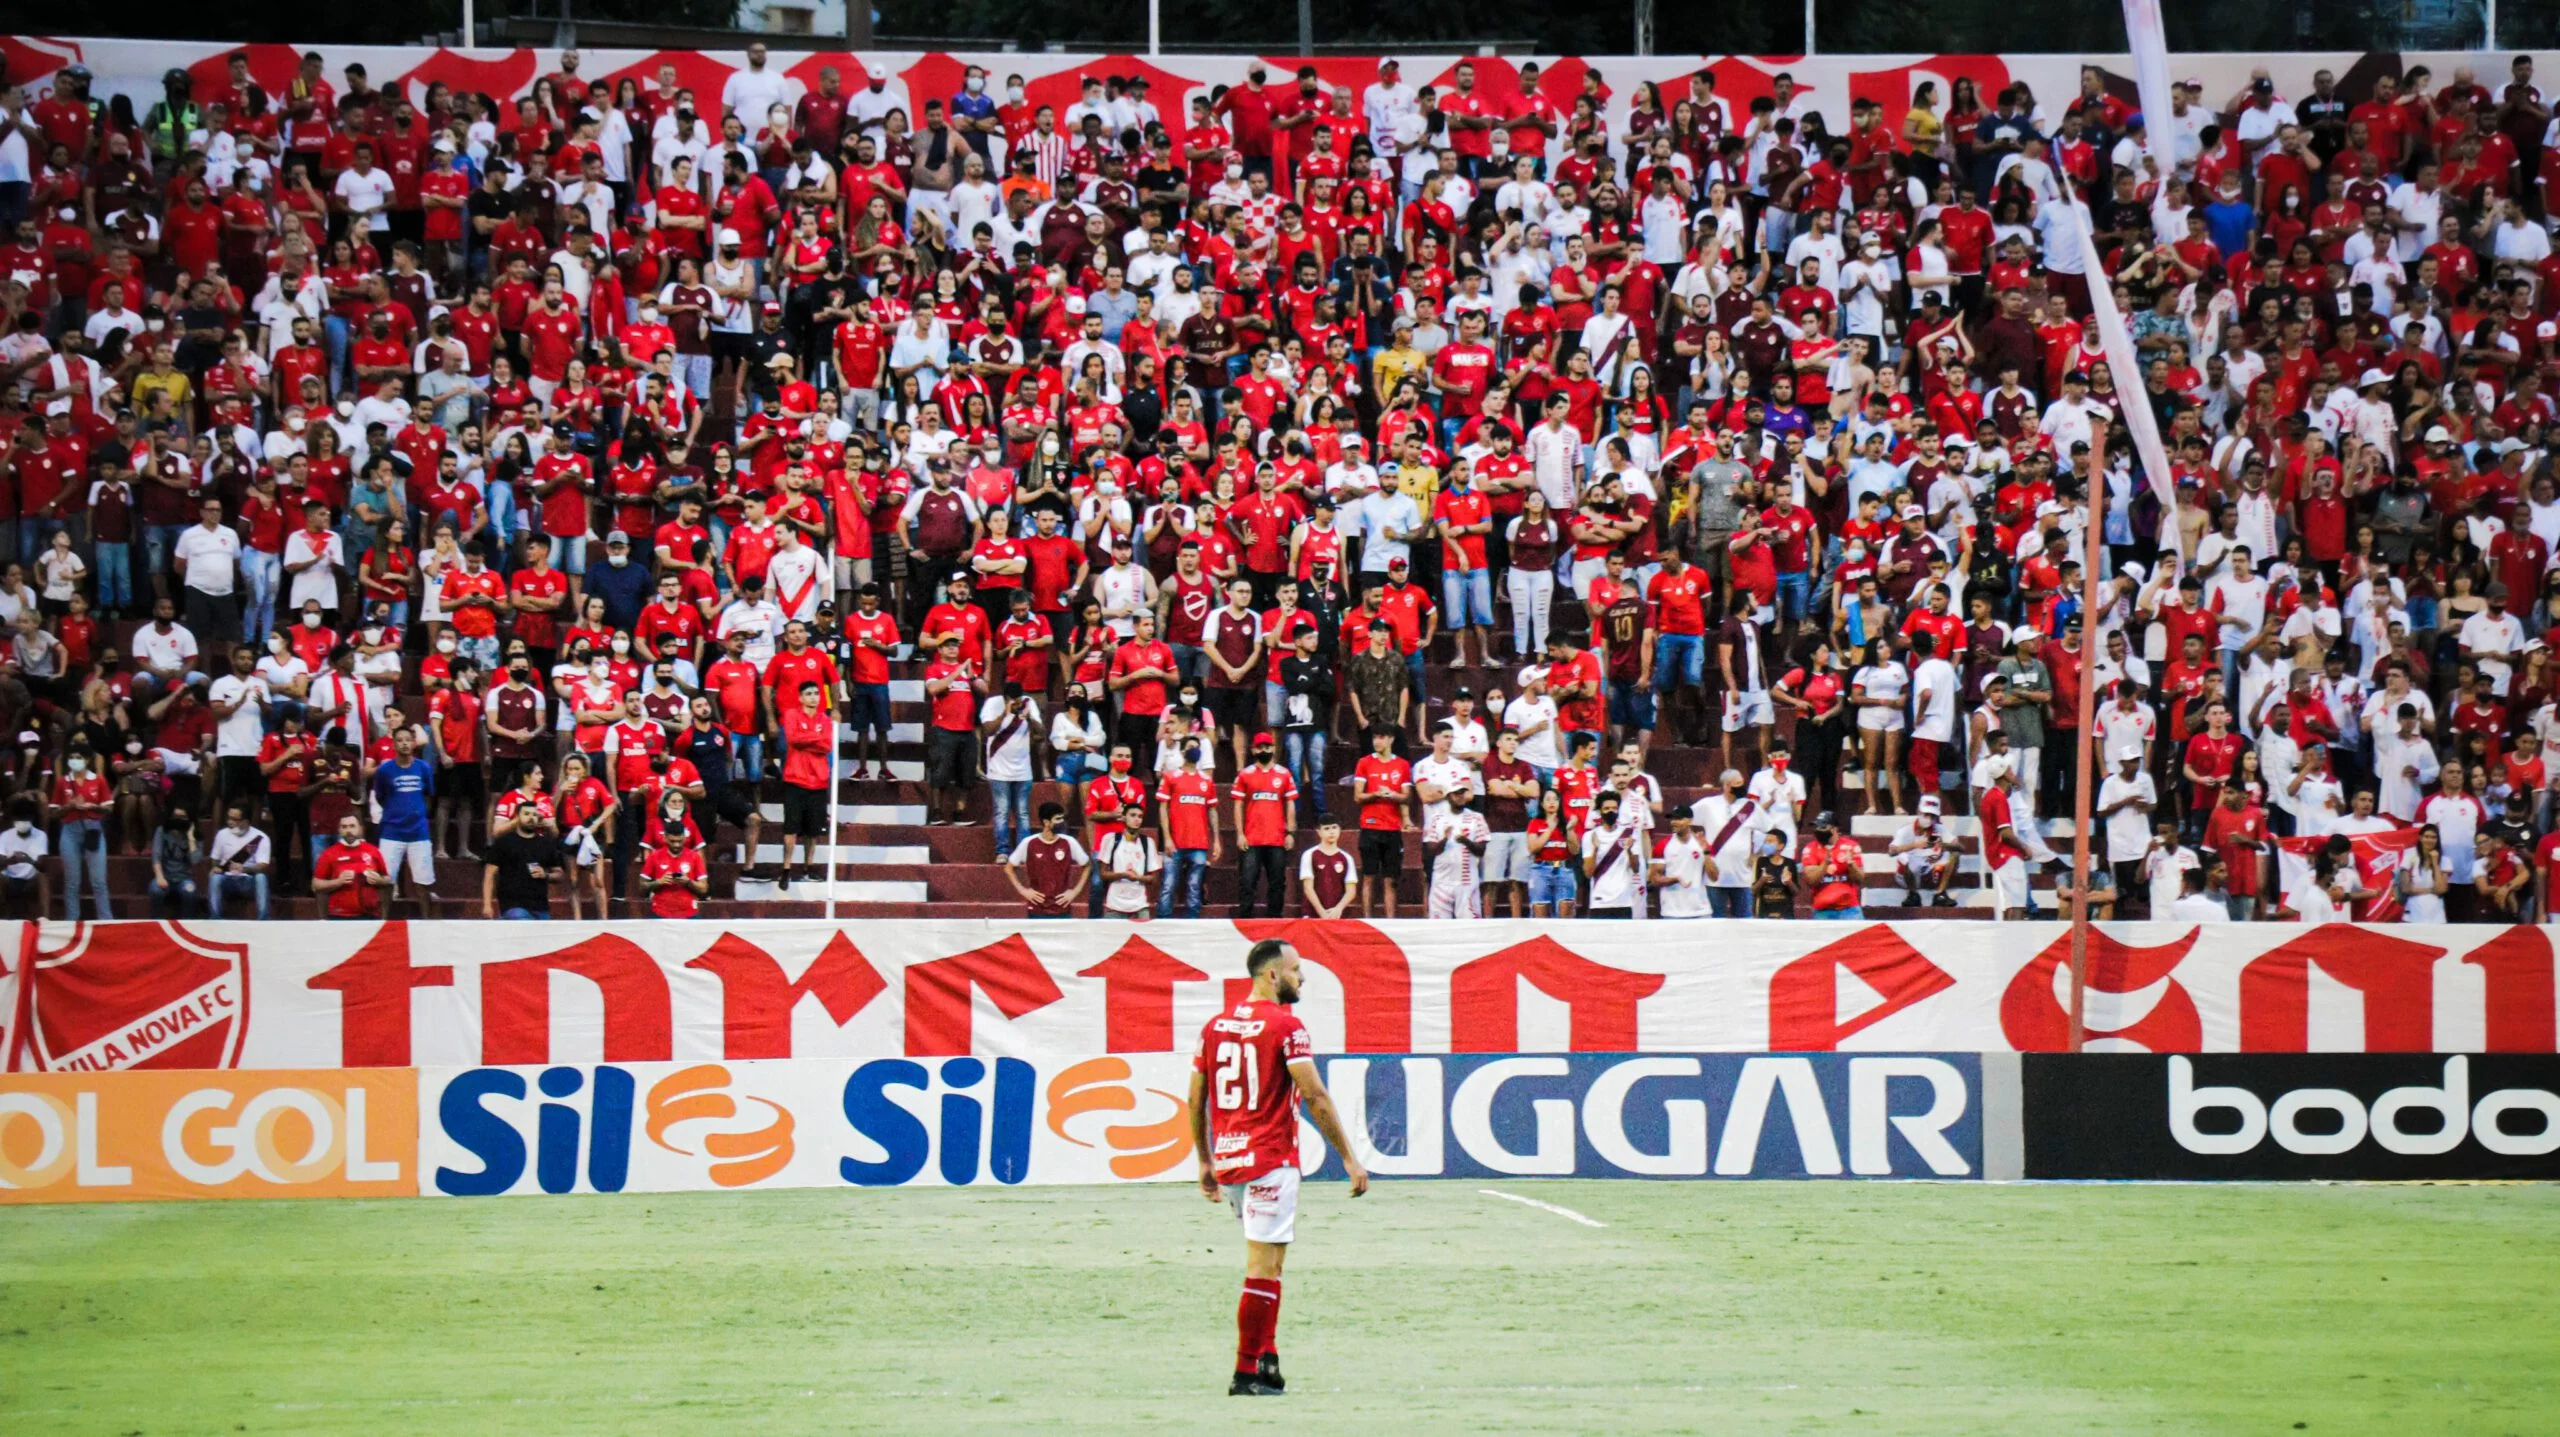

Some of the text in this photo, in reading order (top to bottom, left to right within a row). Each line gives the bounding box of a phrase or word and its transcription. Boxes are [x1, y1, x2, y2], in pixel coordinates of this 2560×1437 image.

[126, 1005, 200, 1054] NOVA
[198, 985, 233, 1016] FC
[436, 1065, 635, 1195] Sil
[840, 1056, 1036, 1185] Sil
[1216, 1042, 1259, 1111] 21
[1303, 1056, 1971, 1177] UGGAR
[0, 1087, 400, 1191] OL GOL
